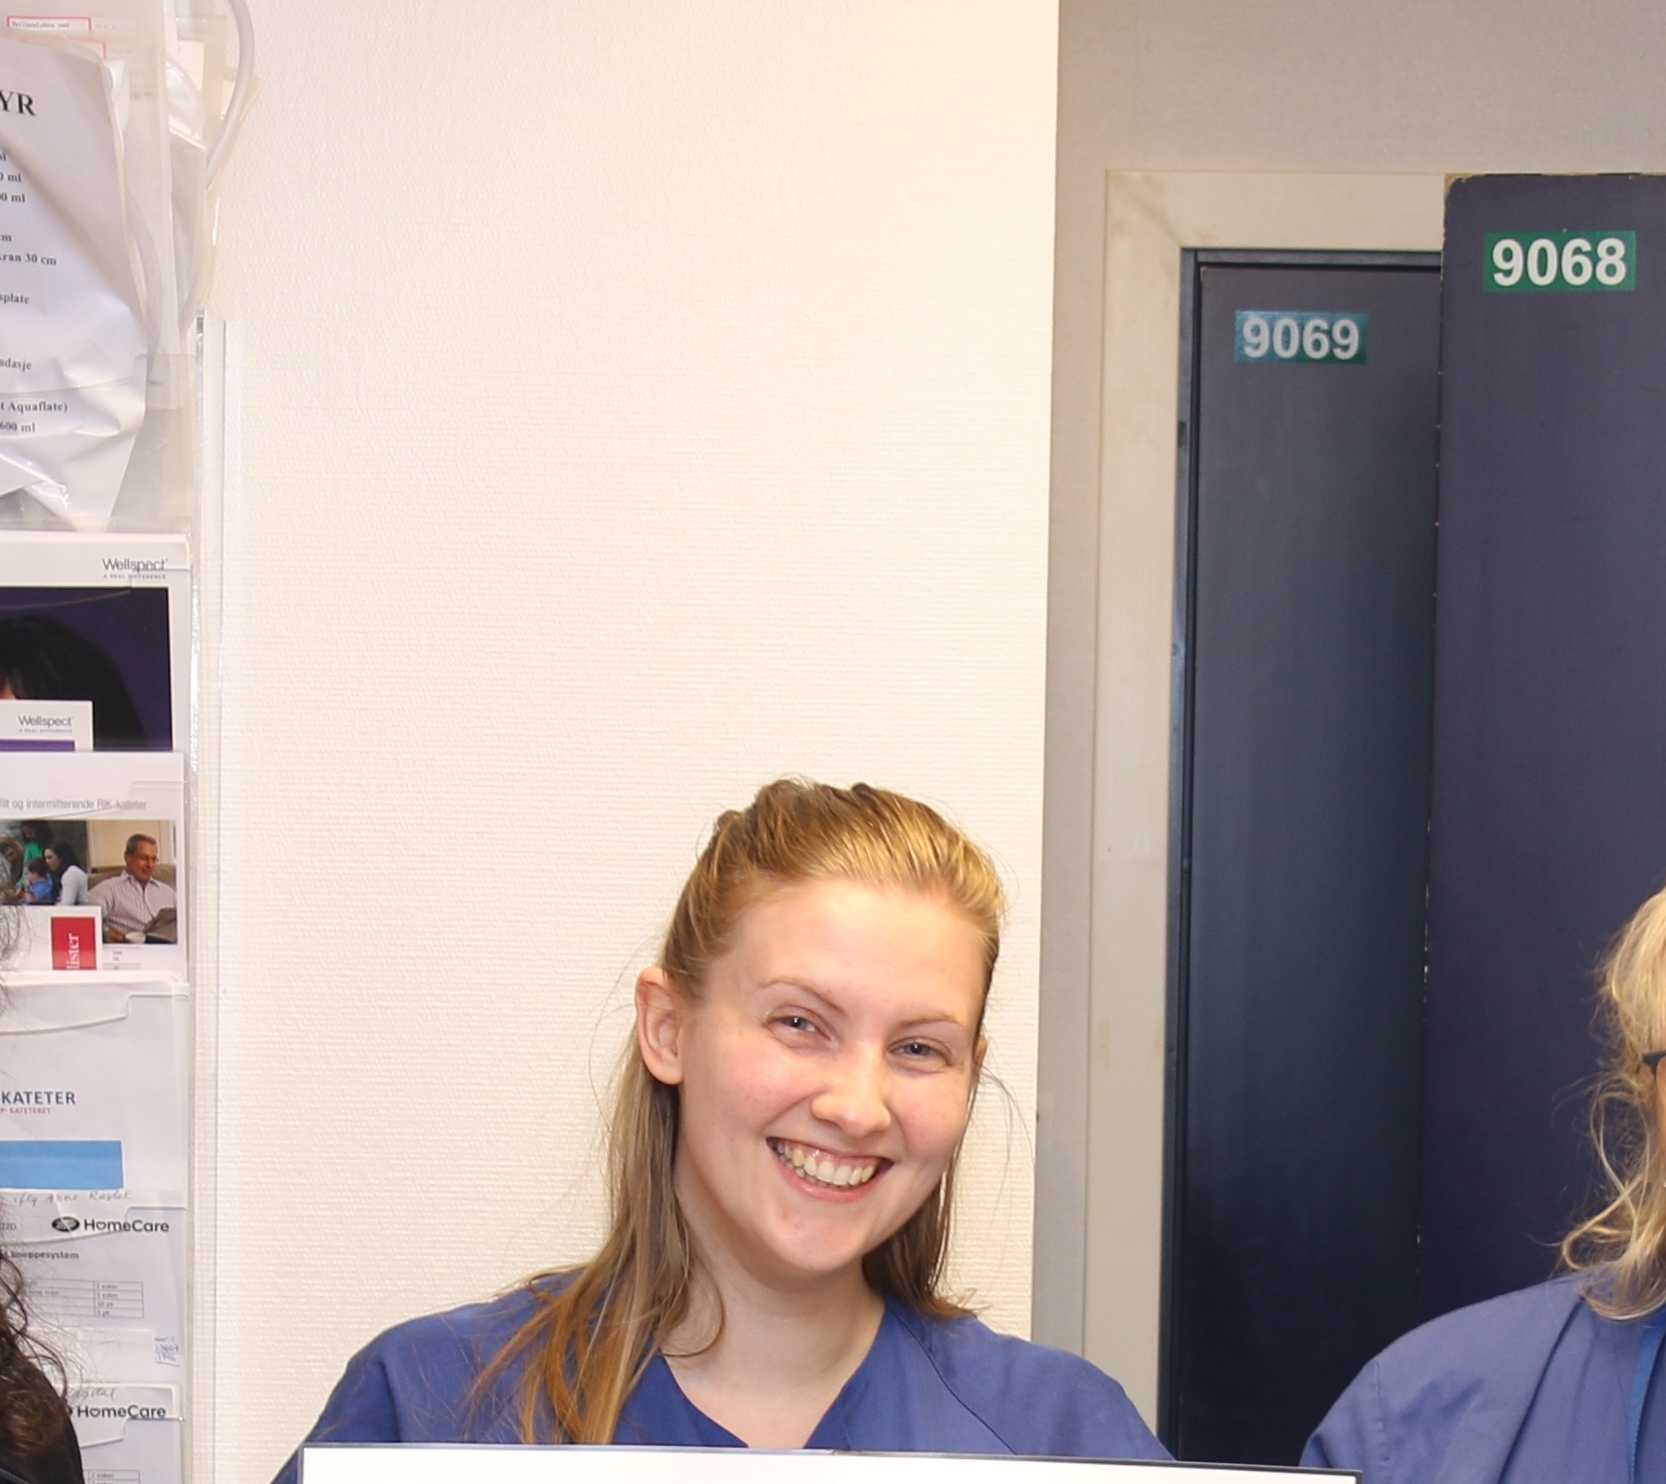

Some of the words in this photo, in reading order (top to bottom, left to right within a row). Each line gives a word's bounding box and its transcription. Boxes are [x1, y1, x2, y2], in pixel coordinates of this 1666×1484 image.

[8, 172, 22, 183] ml
[11, 193, 25, 203] ml
[25, 254, 38, 263] 30
[41, 256, 57, 266] cm
[1491, 237, 1628, 287] 9068
[1241, 316, 1360, 360] 9069
[8, 400, 68, 414] Aquaflate)
[0, 421, 18, 432] 600
[21, 422, 35, 432] ml
[102, 558, 166, 572] Wellspect
[18, 715, 72, 727] Wellspect
[84, 1219, 169, 1232] HomeCare
[77, 1405, 166, 1418] HomeCare
